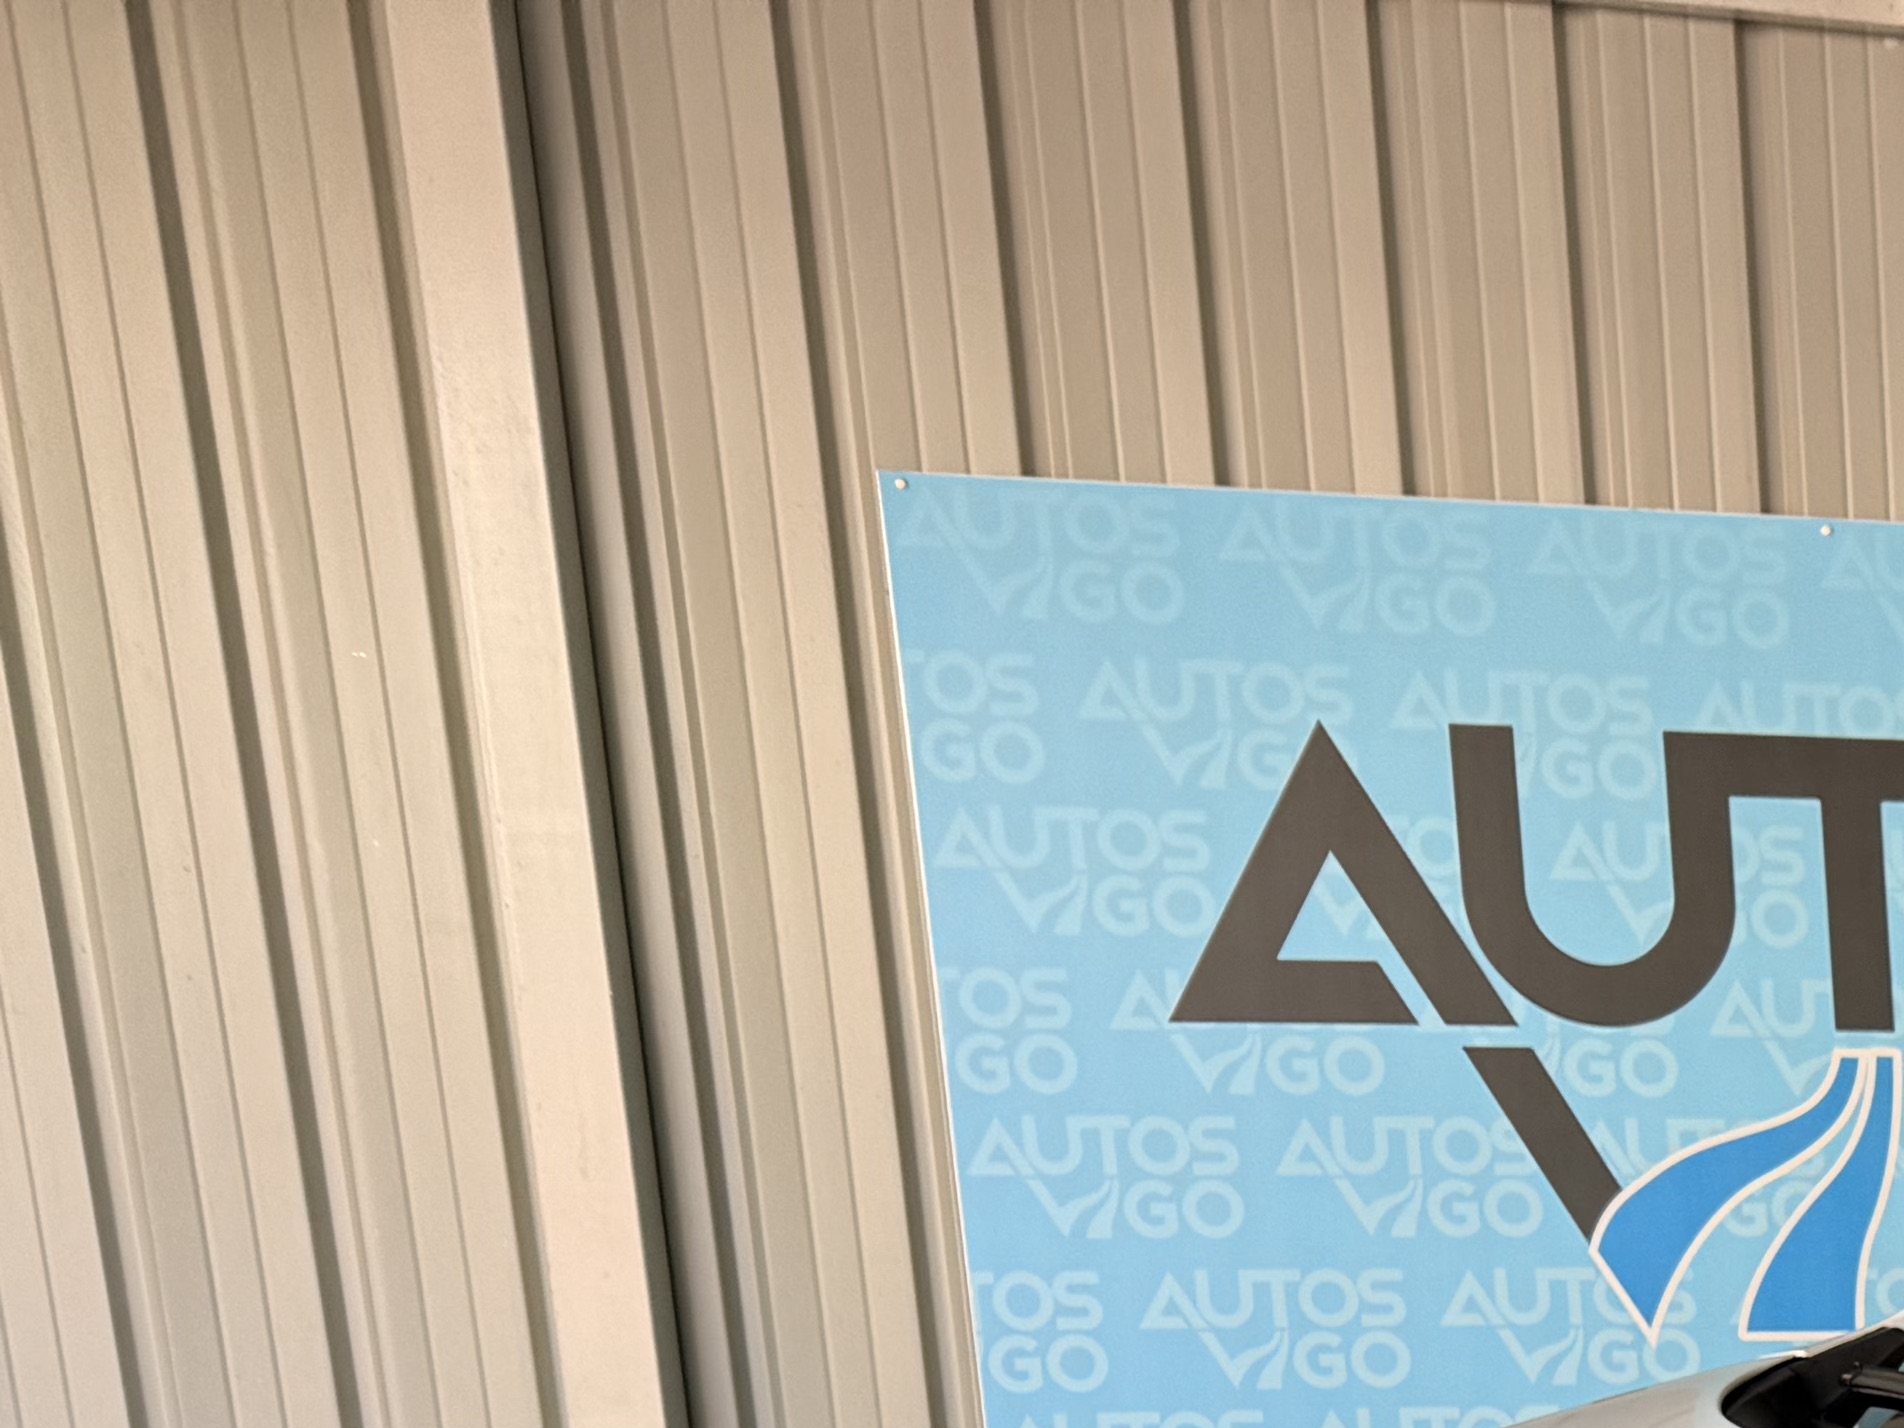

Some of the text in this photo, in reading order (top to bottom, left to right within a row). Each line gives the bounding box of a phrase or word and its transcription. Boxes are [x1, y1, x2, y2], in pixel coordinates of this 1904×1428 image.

[902, 489, 1179, 555] AUTOS
[1221, 501, 1489, 569] AUTOS
[1529, 515, 1785, 582] AUTOS
[959, 549, 1183, 623] VIGO
[1279, 565, 1494, 635] VIGO
[1588, 580, 1789, 648] VIGO
[1079, 657, 1353, 725] AUTOS
[1393, 669, 1652, 735] AUTOS
[935, 807, 1209, 870] AUTOS
[996, 871, 1215, 935] VIGO
[1171, 1031, 1384, 1093] VIGO
[968, 1116, 1238, 1175] AUTOS
[1277, 1117, 1534, 1175] AUTOS
[1026, 1178, 1243, 1238] VIGO
[1335, 1178, 1542, 1235] VIGO
[1140, 1268, 1403, 1328] AUTOS
[1200, 1328, 1409, 1388] VIGO
[1499, 1328, 1698, 1384] VIGO
